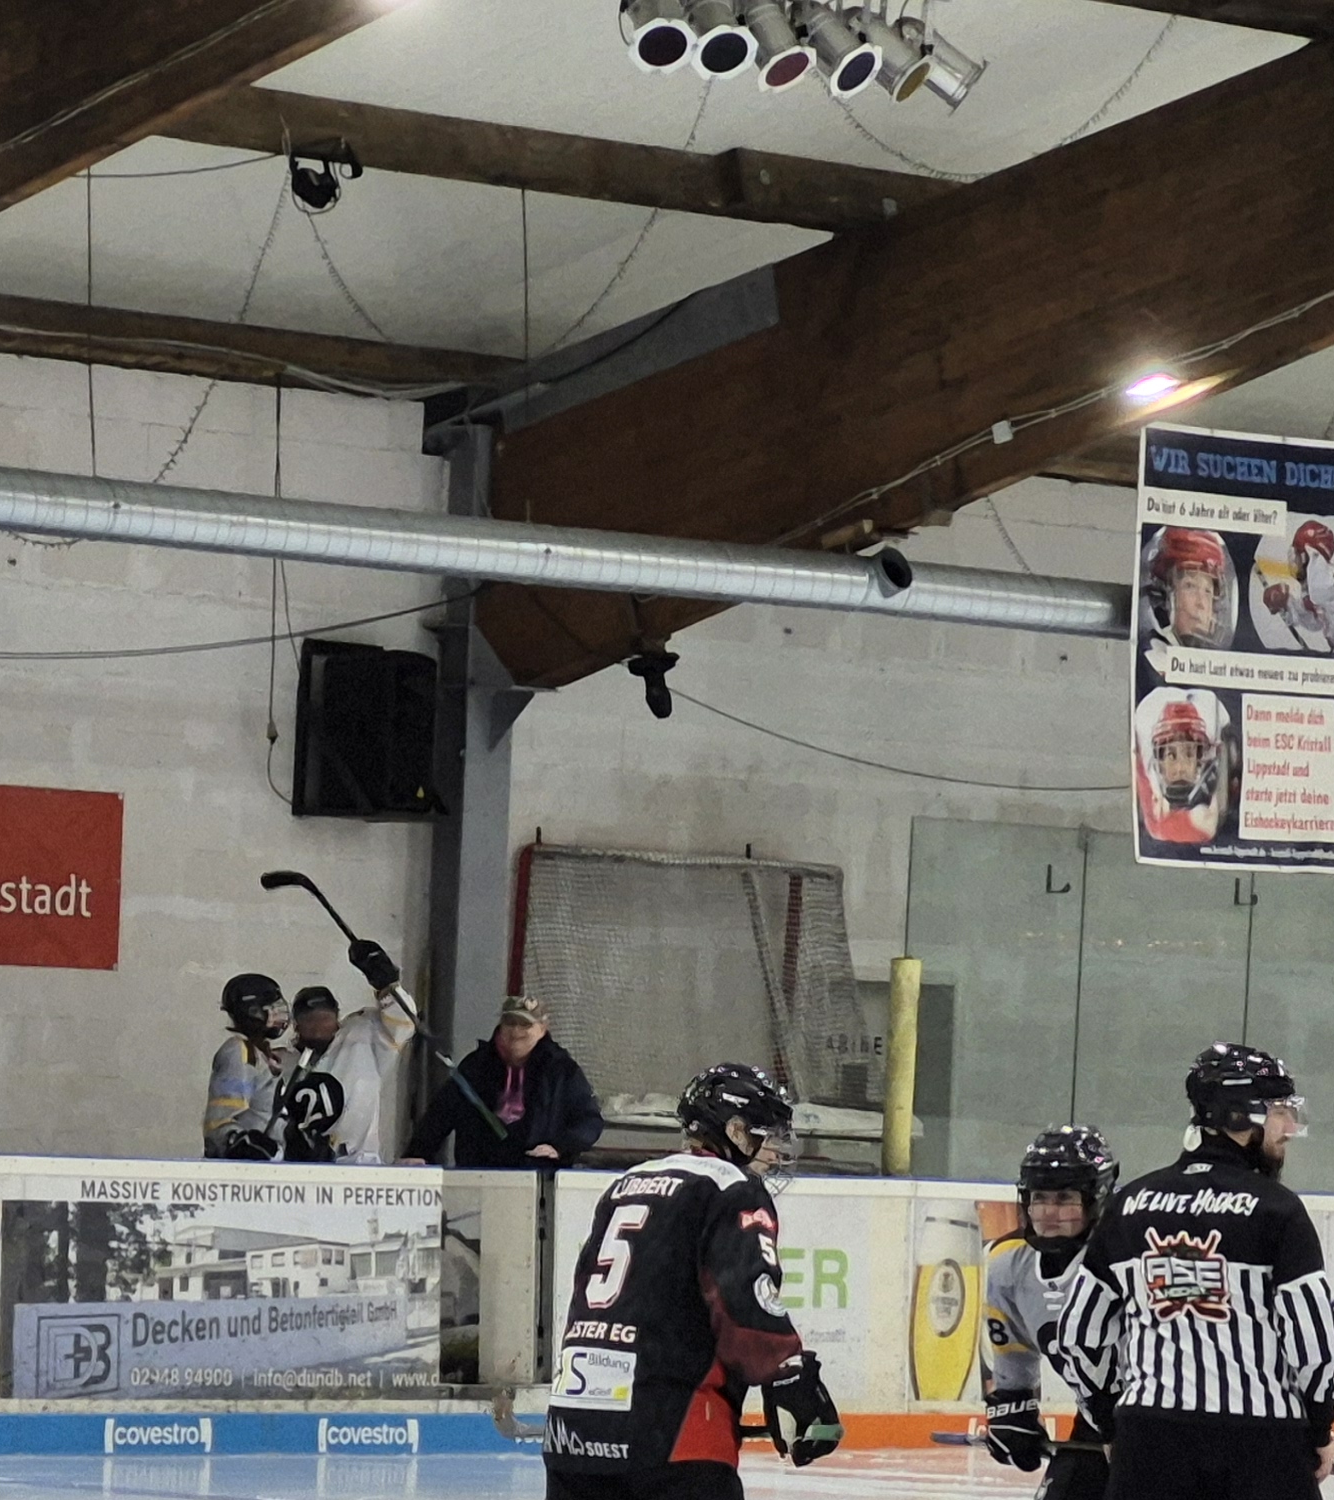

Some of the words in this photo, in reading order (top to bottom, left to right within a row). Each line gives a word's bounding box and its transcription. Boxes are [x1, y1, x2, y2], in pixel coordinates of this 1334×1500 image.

[1150, 445, 1191, 475] WIR
[1196, 452, 1278, 484] SUCHEN
[1147, 497, 1161, 512] Du
[1179, 502, 1186, 516] 6
[1188, 502, 1214, 519] Jahre
[1232, 507, 1250, 521] oder
[1171, 656, 1185, 672] Du
[1209, 660, 1227, 676] Lust
[1230, 664, 1255, 679] etwas
[1258, 668, 1284, 681] neues
[1287, 670, 1299, 682] zu
[1247, 703, 1272, 721] Dann
[1275, 706, 1305, 725] melde
[1307, 707, 1325, 726] dich
[1247, 730, 1271, 748] beim
[1275, 733, 1295, 750] ESC
[1297, 735, 1332, 753] Kristall
[1247, 758, 1290, 779] Lippstadt
[1292, 761, 1310, 778] und
[1245, 786, 1273, 803] starte
[1275, 787, 1297, 808] jetzt
[1300, 786, 1330, 805] deine
[81, 1180, 161, 1200] MASSIVE
[170, 1182, 306, 1204] KONSTRUKTION
[316, 1185, 334, 1205] IN
[343, 1187, 442, 1207] PERFEKTION
[1122, 1187, 1155, 1216] WE
[1148, 1191, 1194, 1215] LIVE
[1189, 1187, 1260, 1217] HOCKEY
[585, 1204, 651, 1310] 5
[758, 1233, 777, 1266] 5
[132, 1310, 221, 1348] Decken
[227, 1306, 263, 1338] und
[268, 1301, 365, 1333] Betonfertigteil
[368, 1301, 398, 1322] GmbH
[609, 1323, 637, 1343] EG
[987, 1318, 1009, 1346] 8
[588, 1353, 631, 1373] Bildung
[184, 1368, 233, 1388] 94900
[253, 1366, 373, 1389] info@dundb.net
[986, 1399, 1042, 1420] BAUE
[114, 1423, 200, 1446] covestro
[327, 1423, 410, 1446] covestro
[585, 1441, 630, 1460] SOEST
